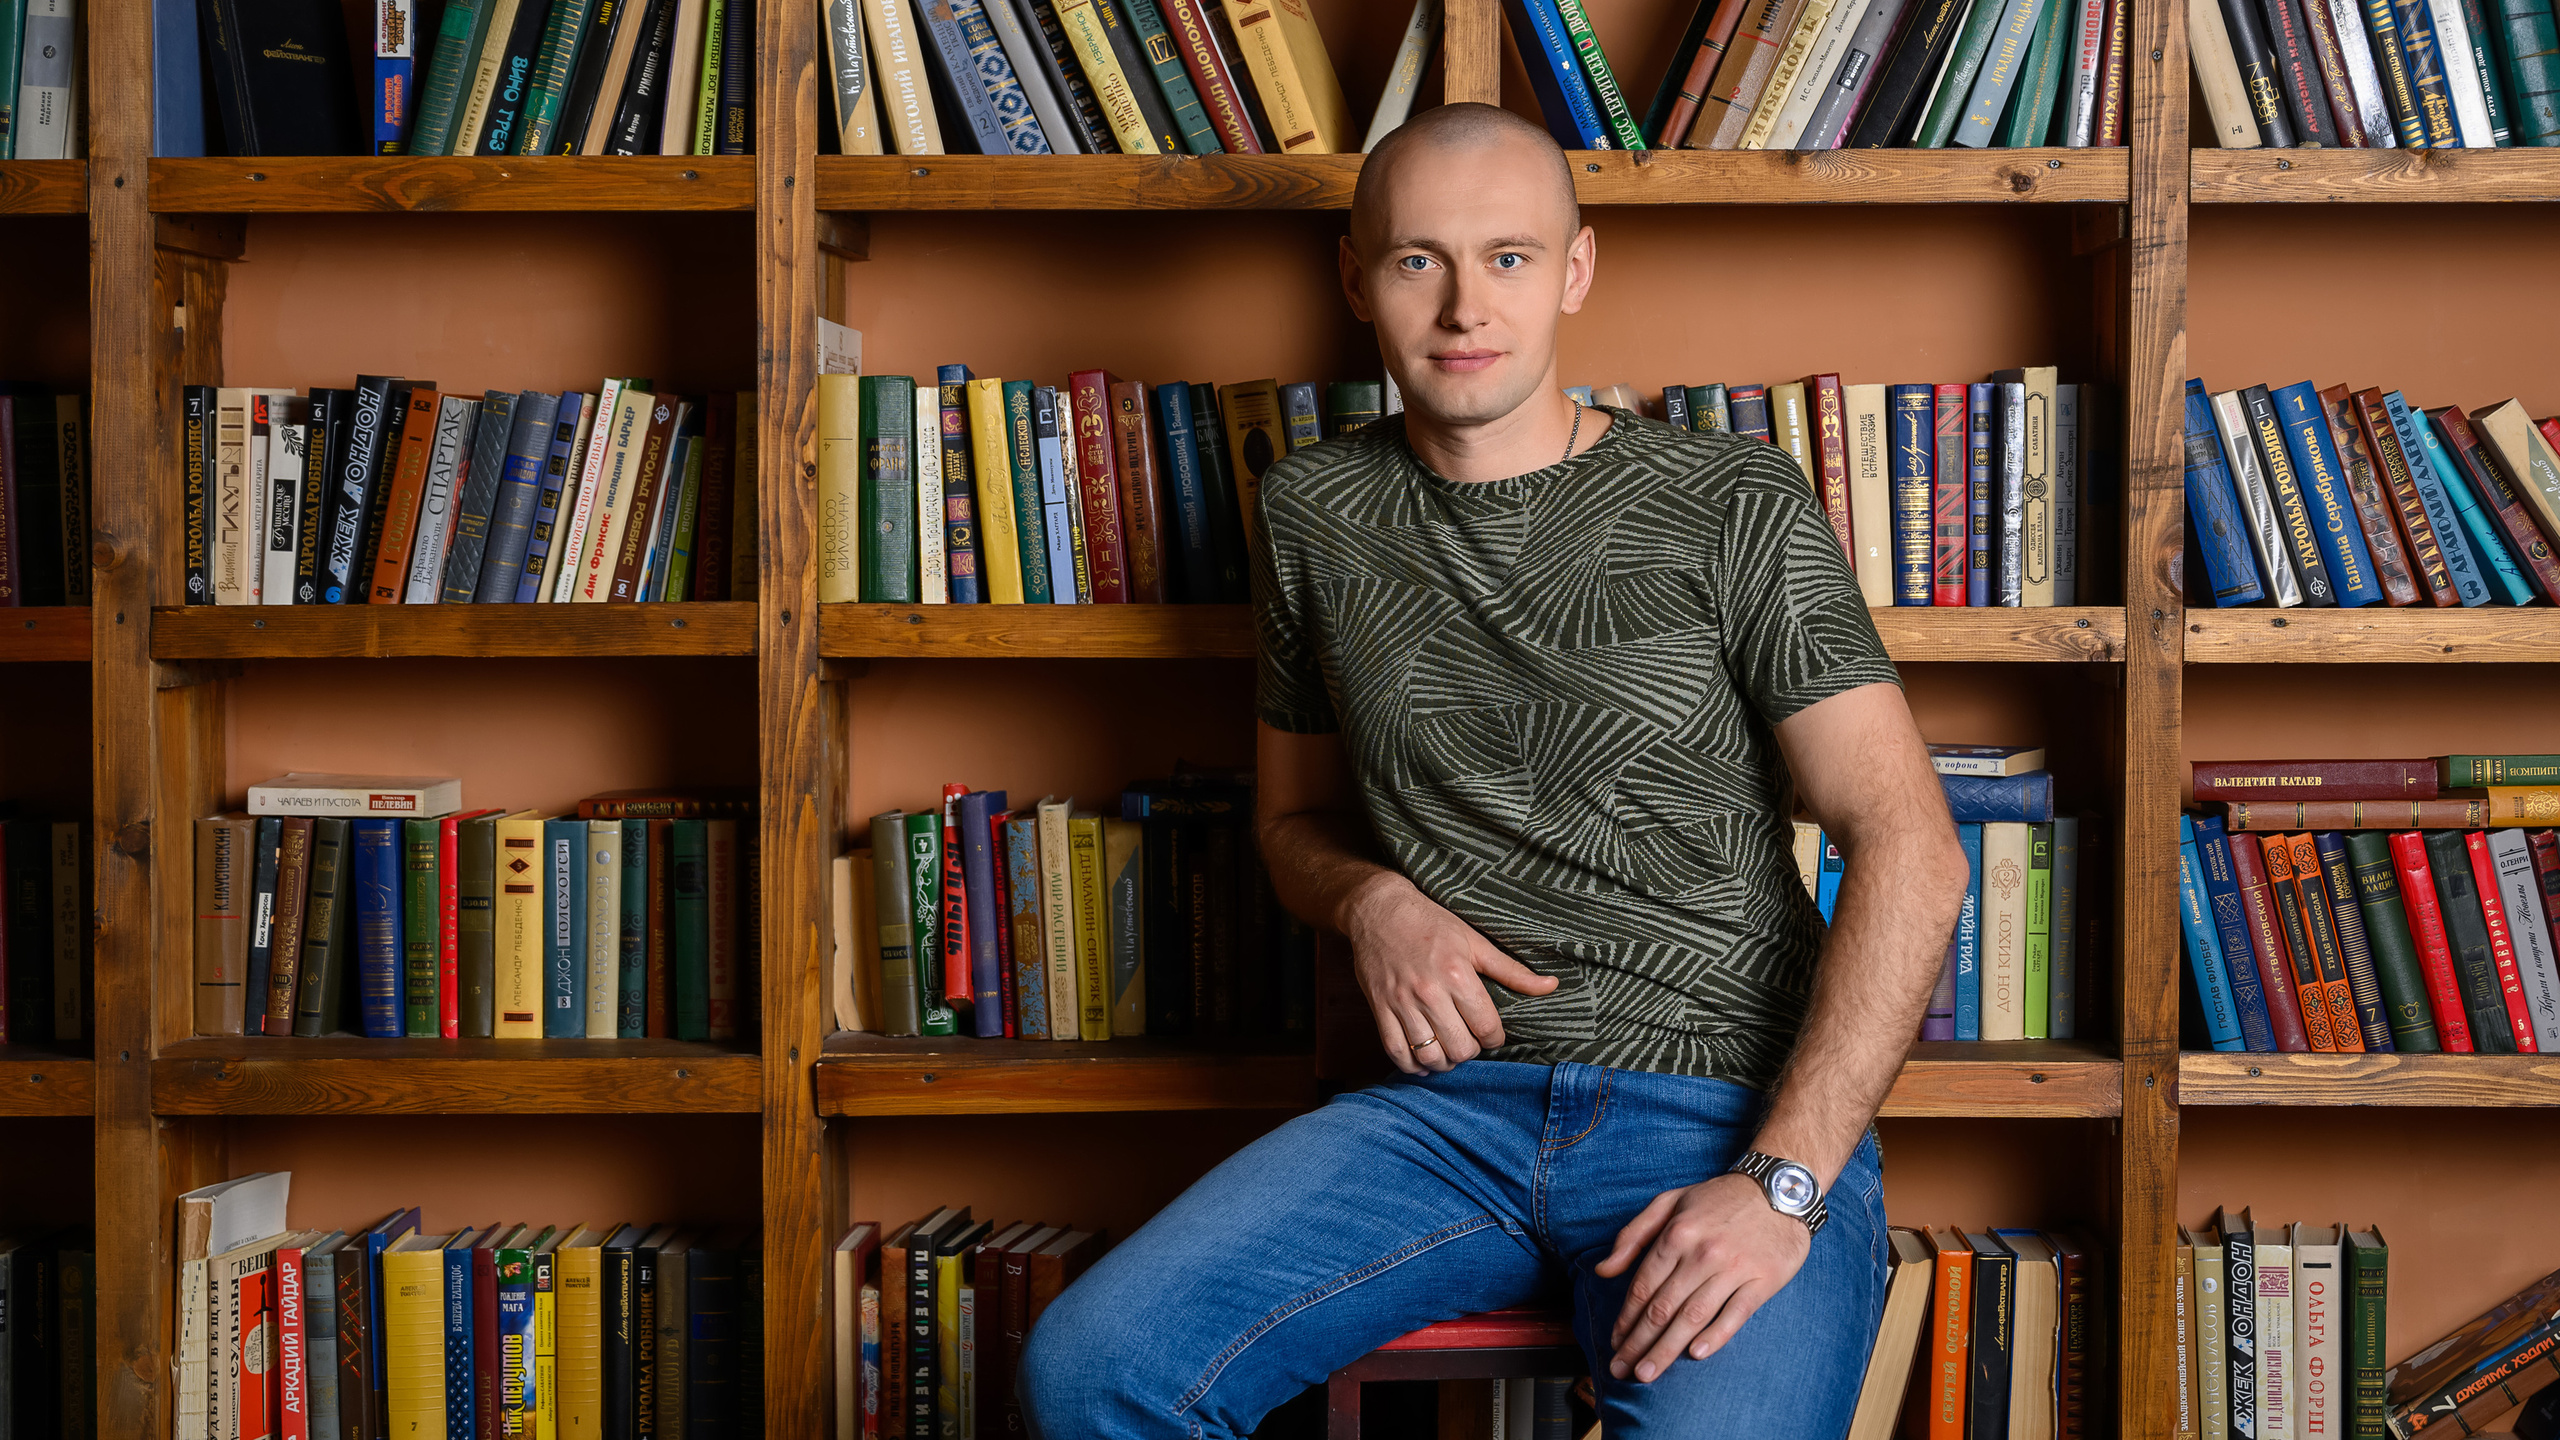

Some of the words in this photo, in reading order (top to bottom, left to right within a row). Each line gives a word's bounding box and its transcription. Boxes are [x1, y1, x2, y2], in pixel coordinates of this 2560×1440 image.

[710, 9, 723, 70] ОГНЕННЫЙ
[1075, 10, 1105, 66] ИЗБРАННОЕ
[1150, 38, 1172, 61] 17
[1255, 26, 1280, 77] ЛЕБЕДЕНКО
[2476, 46, 2487, 67] ДОЙЛ
[505, 55, 529, 103] ВИНО
[708, 73, 718, 95] БОГ
[1108, 72, 1140, 130] ЗОЩЕНКО
[1275, 80, 1299, 130] АЛЕКСАНДР
[1565, 76, 1591, 130] МАРГАРИТА
[1584, 53, 1626, 118] ГЕРРИТСЕН
[1730, 87, 1740, 99] 2
[1751, 38, 1805, 139] ГОРЬКИЙ
[2481, 68, 2492, 93] КОНАН
[489, 108, 515, 151] ГРЕЗ
[701, 96, 716, 155] МАРРАНОВ
[980, 117, 988, 130] 2
[1103, 85, 1131, 134] МИХАИЛ
[1209, 83, 1249, 152] МИХАИЛ
[2485, 95, 2497, 117] АРТУР
[857, 127, 865, 138] 5
[1164, 135, 1175, 151] 3
[1612, 119, 1640, 150] ТЕСС
[191, 402, 198, 412] 7
[314, 406, 322, 418] 6
[1123, 400, 1132, 410] 3
[1673, 402, 1681, 413] 3
[2293, 394, 2306, 412] 1
[188, 419, 203, 495] РОББИНС
[308, 428, 324, 502] РОББИНС
[343, 386, 381, 504] ЛОНДОН
[428, 408, 462, 516] СПАРТАК
[1860, 413, 1870, 478] ПУТЕШЕСТВИЕ
[2261, 419, 2294, 496] РОББИНС
[2387, 398, 2432, 481] АЛЕКСИН
[2424, 432, 2438, 450] 8
[639, 435, 662, 498] ГАРОЛЬД
[2304, 426, 2344, 533] Серебрякова
[567, 486, 592, 566] КОРОЛЕВСТВО
[585, 434, 604, 484] КРИВЫХ
[329, 504, 359, 586] ДЖЕК
[623, 500, 646, 567] РОББИНС
[823, 499, 837, 579] СОФРОНОВ
[837, 491, 850, 571] АНАТОЛИЙ
[1870, 546, 1878, 557] 2
[2284, 494, 2319, 569] ГАРОЛЬД
[2420, 485, 2471, 574] АНАТОЛИЙ
[2336, 535, 2364, 592] Галина
[2435, 574, 2446, 587] 4
[325, 586, 342, 604] 6
[1944, 760, 1978, 770] ворона
[2214, 776, 2276, 787] ВАЛЕНТИН
[2280, 776, 2322, 786] КАТАЕВ
[278, 796, 313, 808] ЧАПАЕВ
[322, 797, 362, 808] ПУСТОТА
[371, 799, 414, 810] ПЕЛЕВИН
[1051, 871, 1064, 902] МИР
[2003, 872, 2010, 883] 2
[2361, 869, 2394, 885] ВИЛИС
[2364, 879, 2396, 894] ЛАЦИС
[514, 898, 523, 952] ЛЕБЕДЕНКО
[1052, 904, 1068, 974] РАСТЕНИЙ
[1998, 910, 2012, 969] КИХОТ
[214, 968, 222, 978] 3
[513, 954, 522, 1008] АЛЕКСАНДР
[557, 948, 572, 994] ДЖОН
[1959, 944, 1974, 976] РИД
[2200, 938, 2218, 982] ФЛОБЕР
[1997, 974, 2012, 1012] ДОН
[2208, 982, 2228, 1029] ГЮСТАВ
[2366, 1008, 2376, 1022] 7
[2518, 1018, 2525, 1030] 5
[282, 1262, 298, 1326] ГАЙДАР
[502, 1302, 524, 1312] МАГА
[914, 1250, 929, 1336] ПИТЕР
[1946, 1265, 1962, 1354] ОСТРОВОЙ
[2232, 1241, 2253, 1357] ЛОНДОН
[2308, 1281, 2325, 1348] ОЛЬГА
[640, 1288, 654, 1360] РОББИНС
[284, 1333, 301, 1413] АРКАДИЙ
[502, 1334, 527, 1404] ПЕРУМОВ
[1942, 1361, 1958, 1424] СЕРГЕЙ
[2431, 1394, 2457, 1413] 7
[2455, 1363, 2512, 1404] ДЖЕЙМС
[2510, 1336, 2555, 1369] ХЭДЛИ
[915, 1367, 929, 1436] ЧЕЙН
[2233, 1360, 2254, 1440] ДЖЕК
[2308, 1357, 2325, 1434] ФОРШ
[411, 1422, 418, 1432] 7
